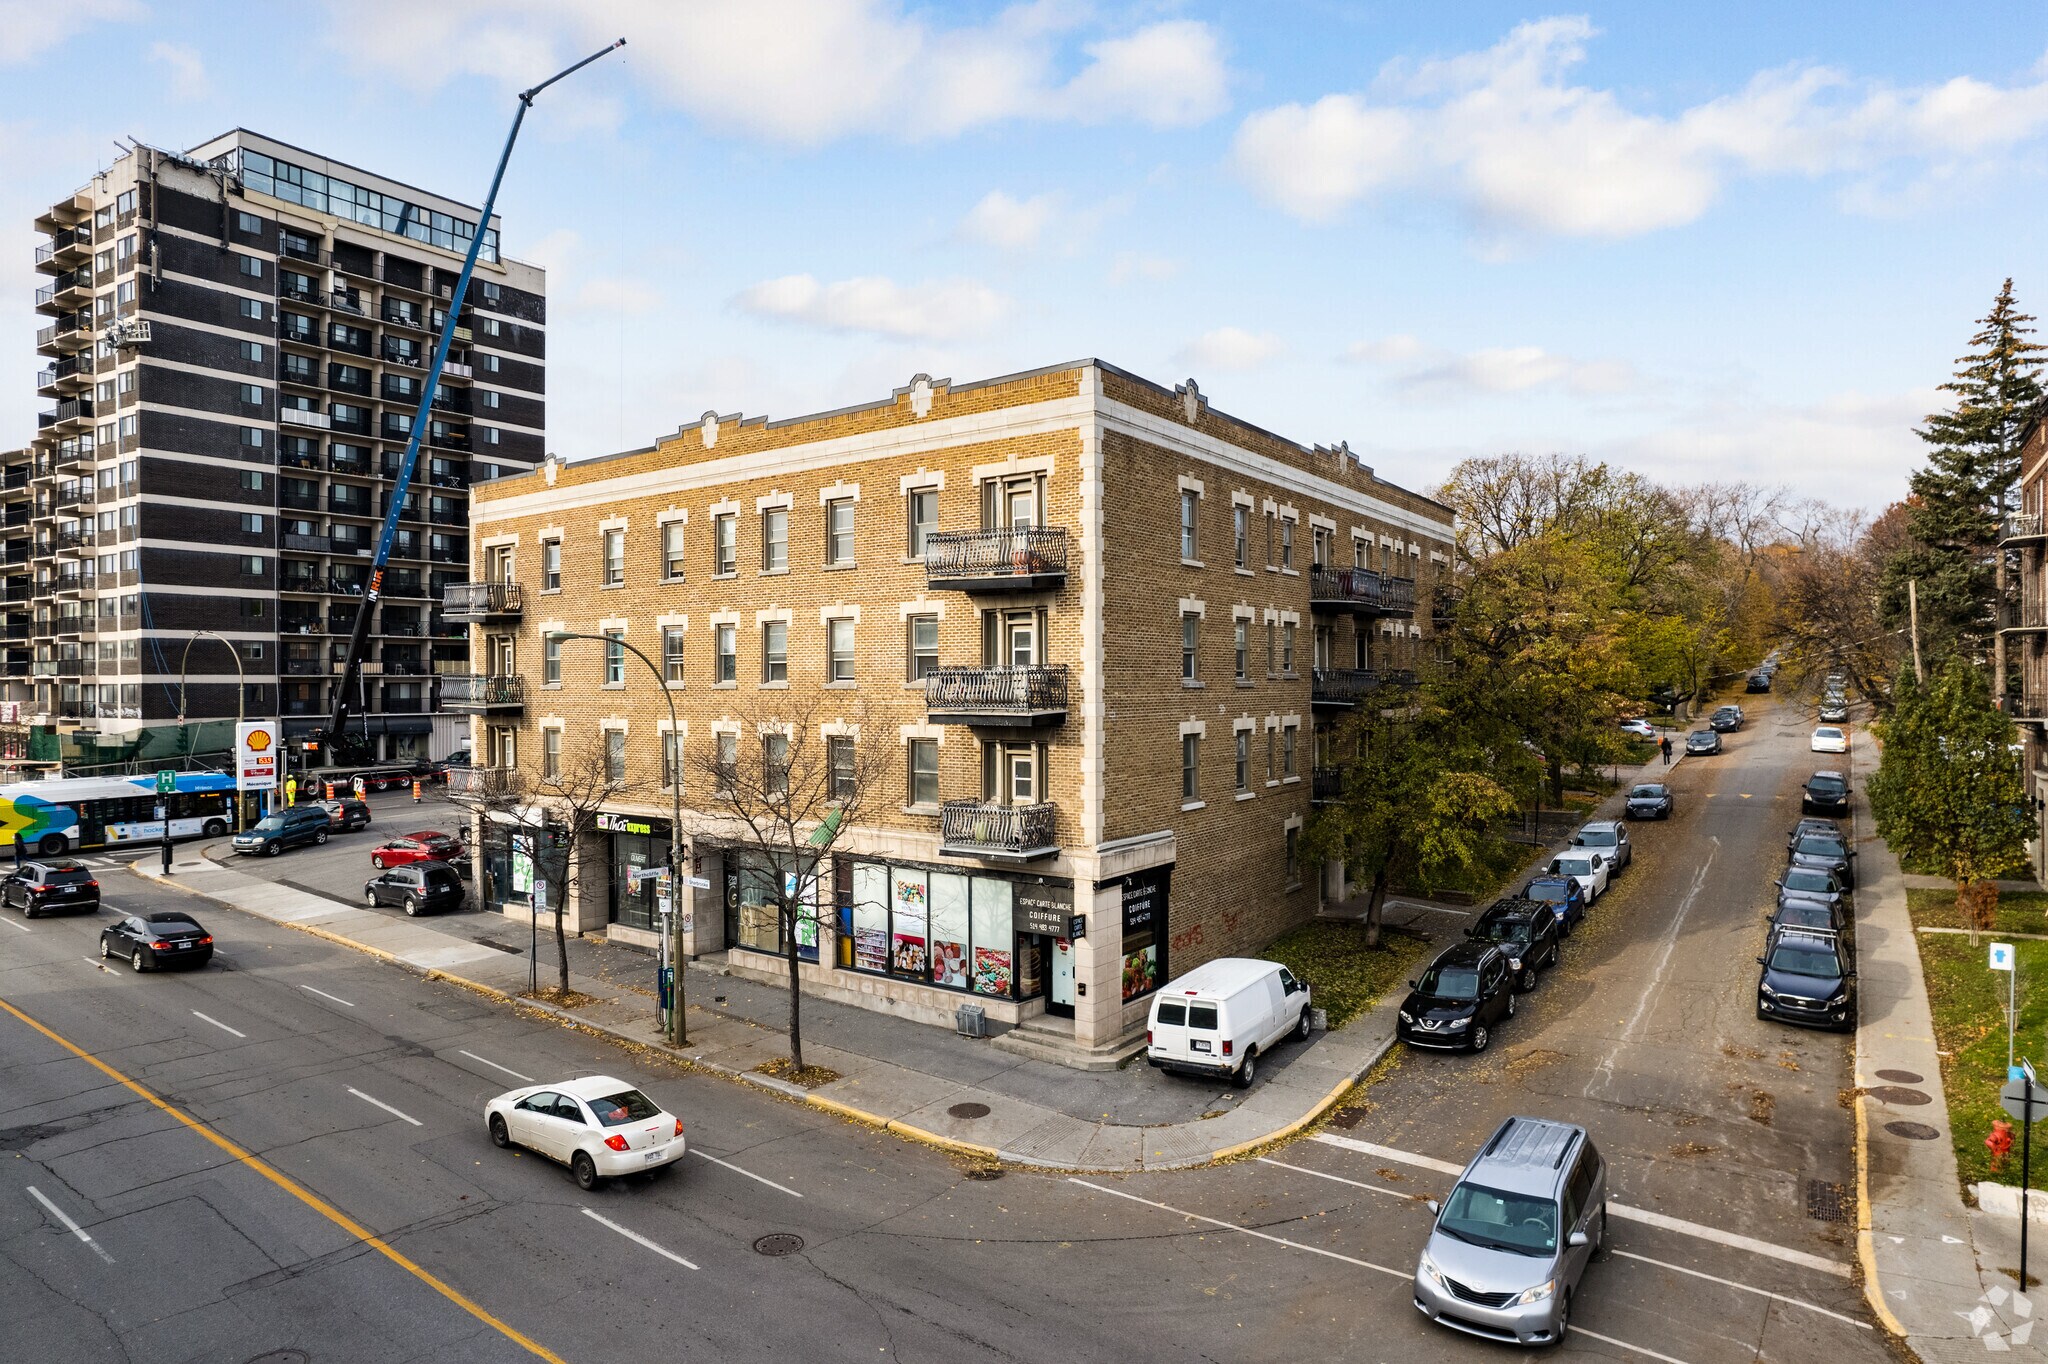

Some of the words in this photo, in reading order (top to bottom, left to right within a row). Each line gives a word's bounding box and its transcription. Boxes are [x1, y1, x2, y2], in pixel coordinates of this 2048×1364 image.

[161, 773, 173, 784] H
[604, 813, 629, 832] Thaï
[627, 823, 651, 835] express
[632, 871, 660, 879] Northcliffe
[1019, 897, 1036, 906] ESPACE
[1036, 899, 1051, 909] CARTE
[1051, 901, 1072, 911] BLANCHE
[1029, 911, 1061, 922] COIFFURE
[1029, 922, 1038, 930] 514
[1048, 925, 1060, 933] 4777
